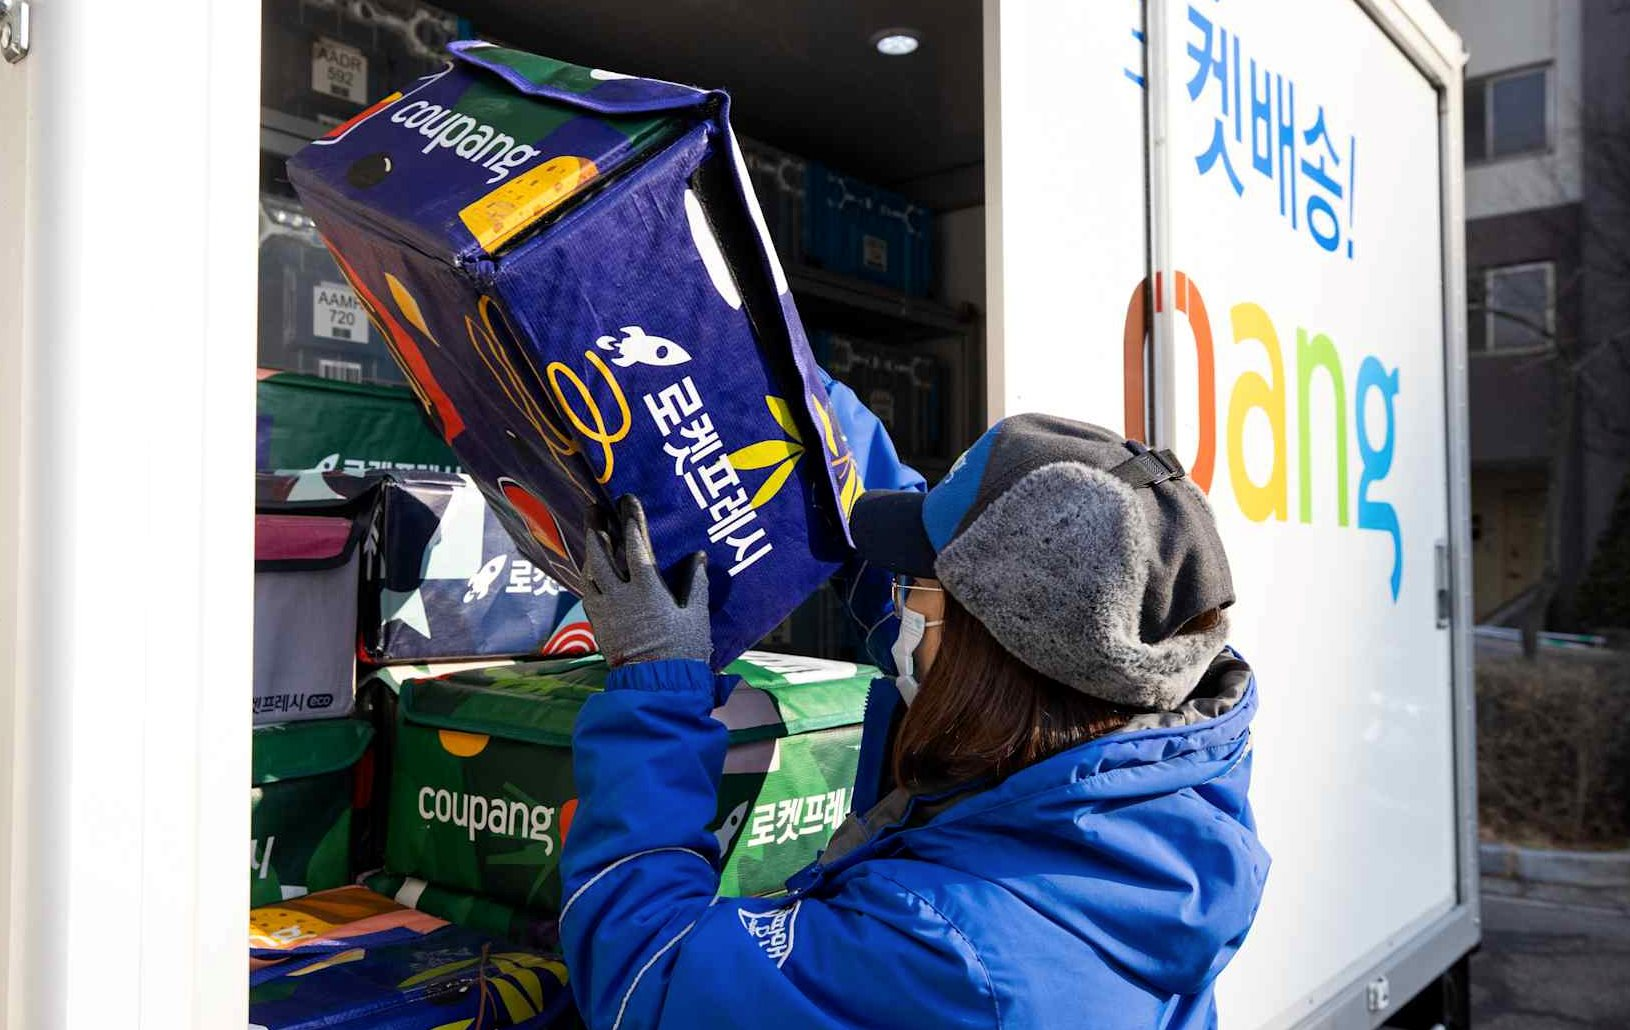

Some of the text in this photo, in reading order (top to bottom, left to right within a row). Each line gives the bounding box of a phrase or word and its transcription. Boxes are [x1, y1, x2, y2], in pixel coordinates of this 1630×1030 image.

[317, 48, 362, 72] AADR
[327, 66, 354, 87] 592
[391, 100, 541, 184] coupang
[1124, 5, 1355, 260] 켓배송!
[329, 309, 355, 326] 720
[643, 376, 773, 577] 로켓프레시
[418, 786, 555, 856] coupang
[748, 787, 853, 847] 로켓프레
